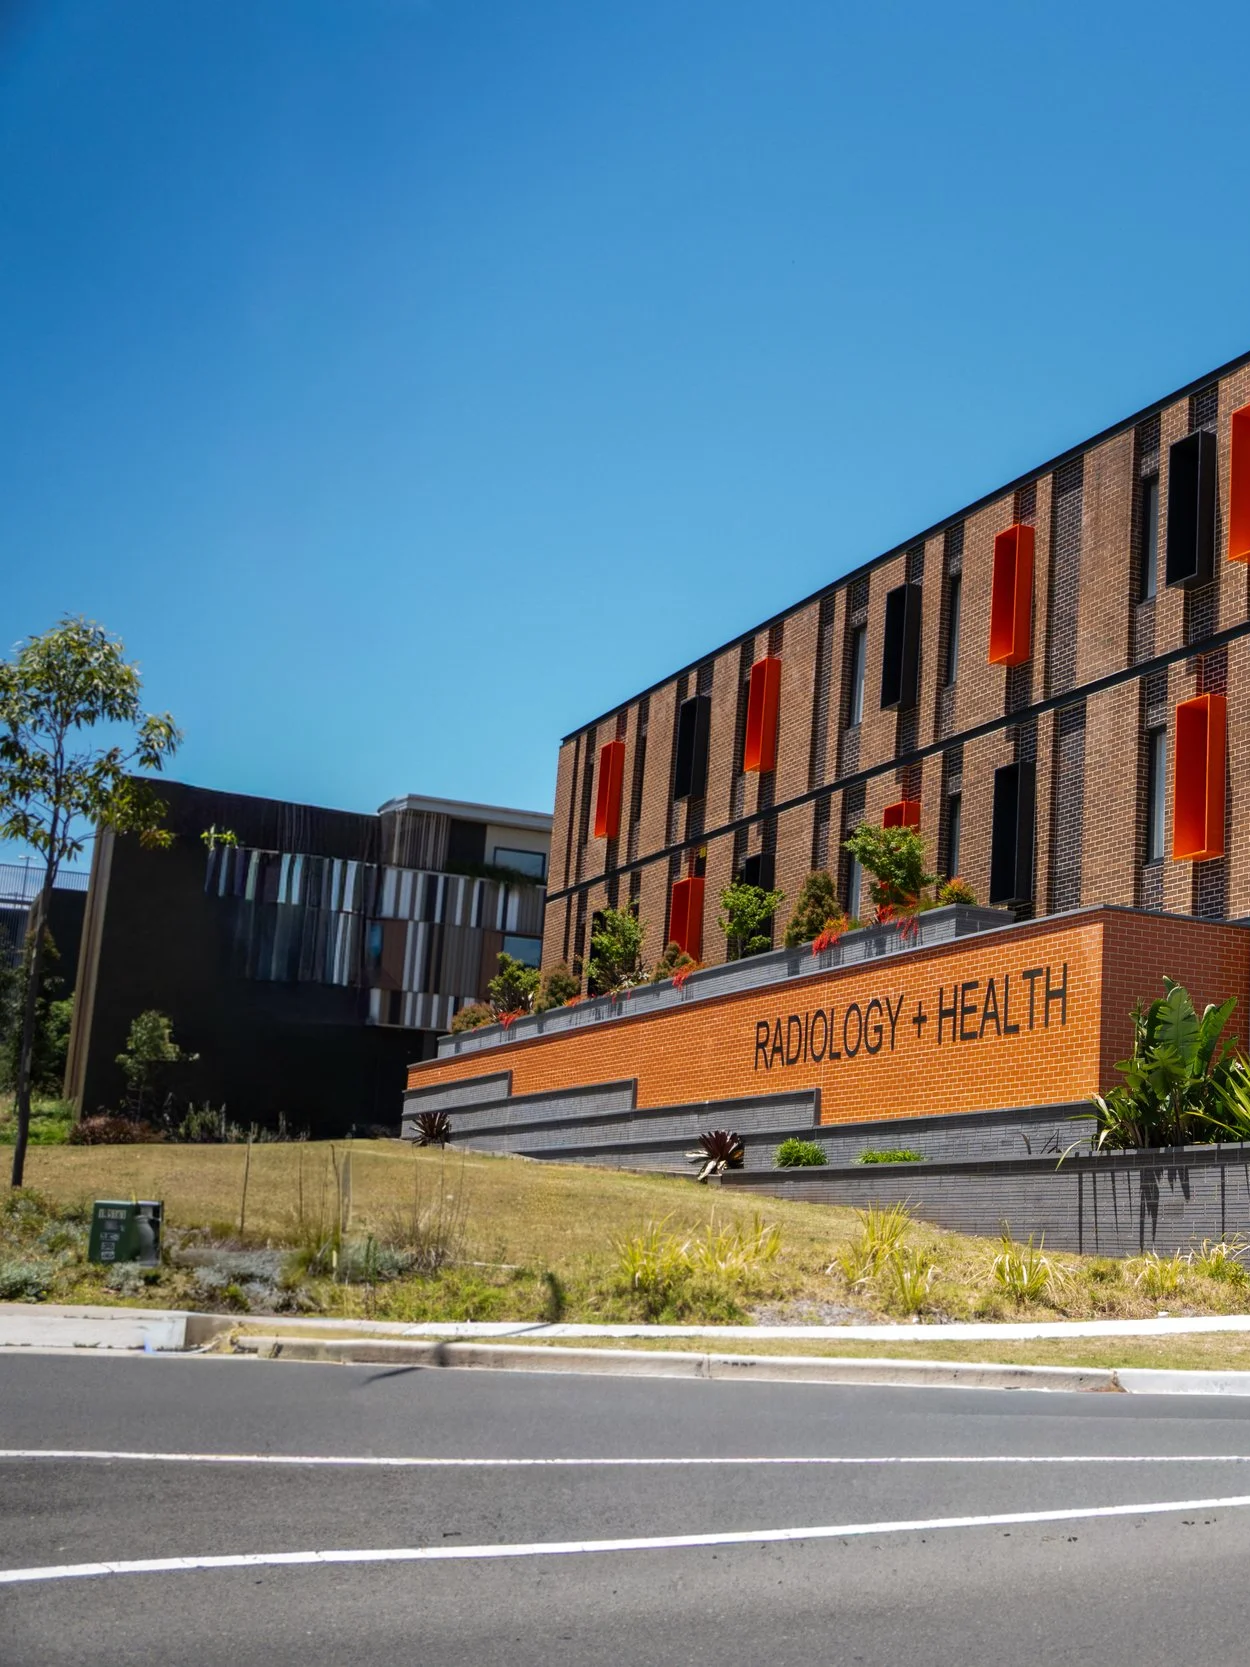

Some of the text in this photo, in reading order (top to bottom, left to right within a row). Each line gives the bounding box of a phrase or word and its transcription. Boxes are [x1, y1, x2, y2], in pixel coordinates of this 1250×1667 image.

[754, 962, 1067, 1070] RADIOLOGY + HEALTH
